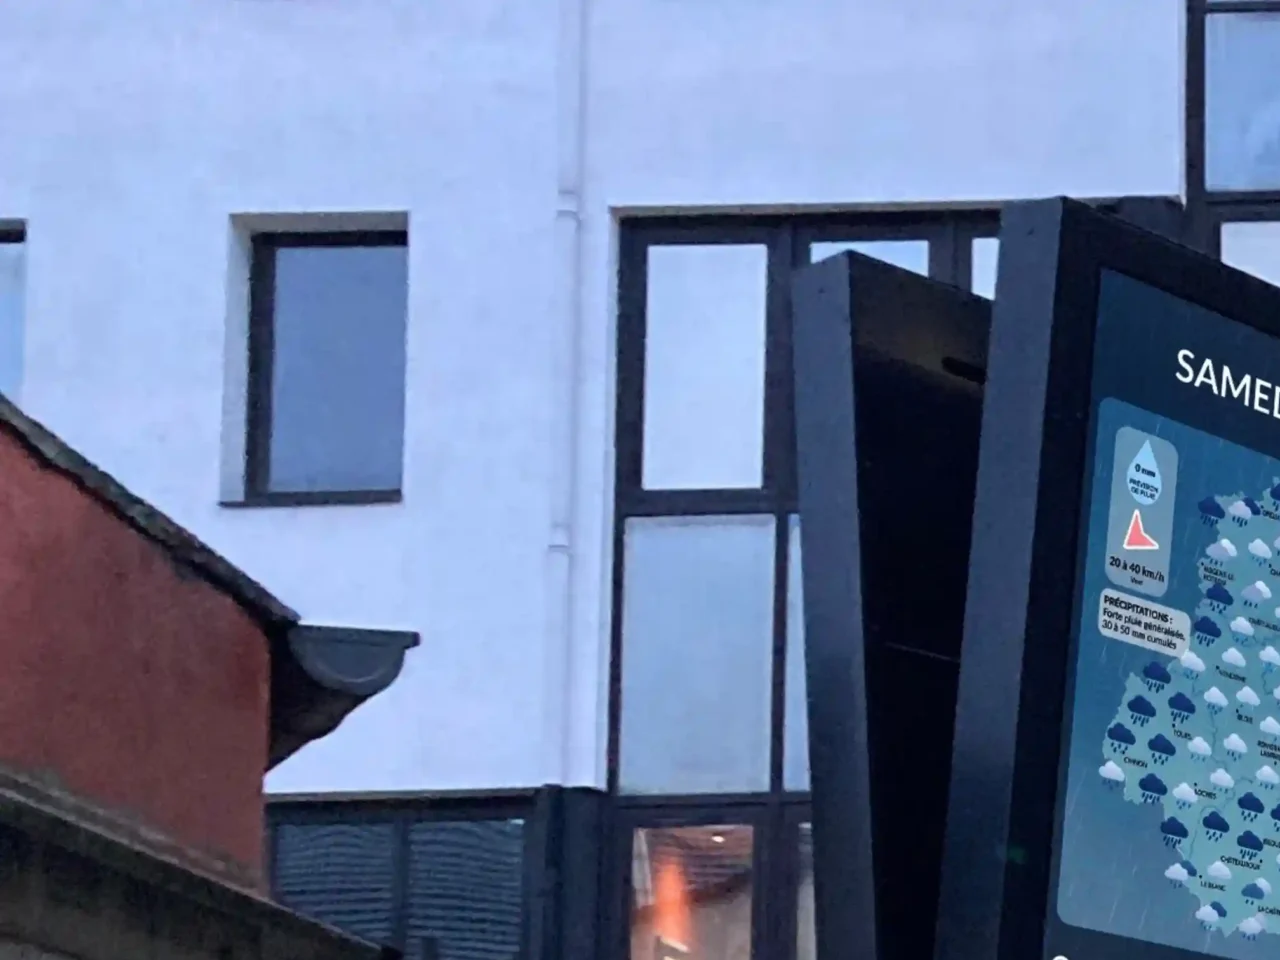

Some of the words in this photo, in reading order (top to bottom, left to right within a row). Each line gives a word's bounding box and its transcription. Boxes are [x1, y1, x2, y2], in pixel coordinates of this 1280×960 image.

[1110, 556, 1121, 568] 20
[1122, 560, 1128, 571] à
[1129, 562, 1141, 574] 40
[1142, 566, 1165, 583] km/h
[1103, 608, 1123, 621] Forte
[1124, 614, 1142, 628] pluie
[1104, 595, 1169, 623] PRÉCIPITATIONS
[1102, 619, 1113, 630] 30
[1113, 623, 1119, 632] à
[1120, 625, 1130, 636] 50
[1131, 629, 1146, 640] mm
[1147, 635, 1177, 650] cumulés
